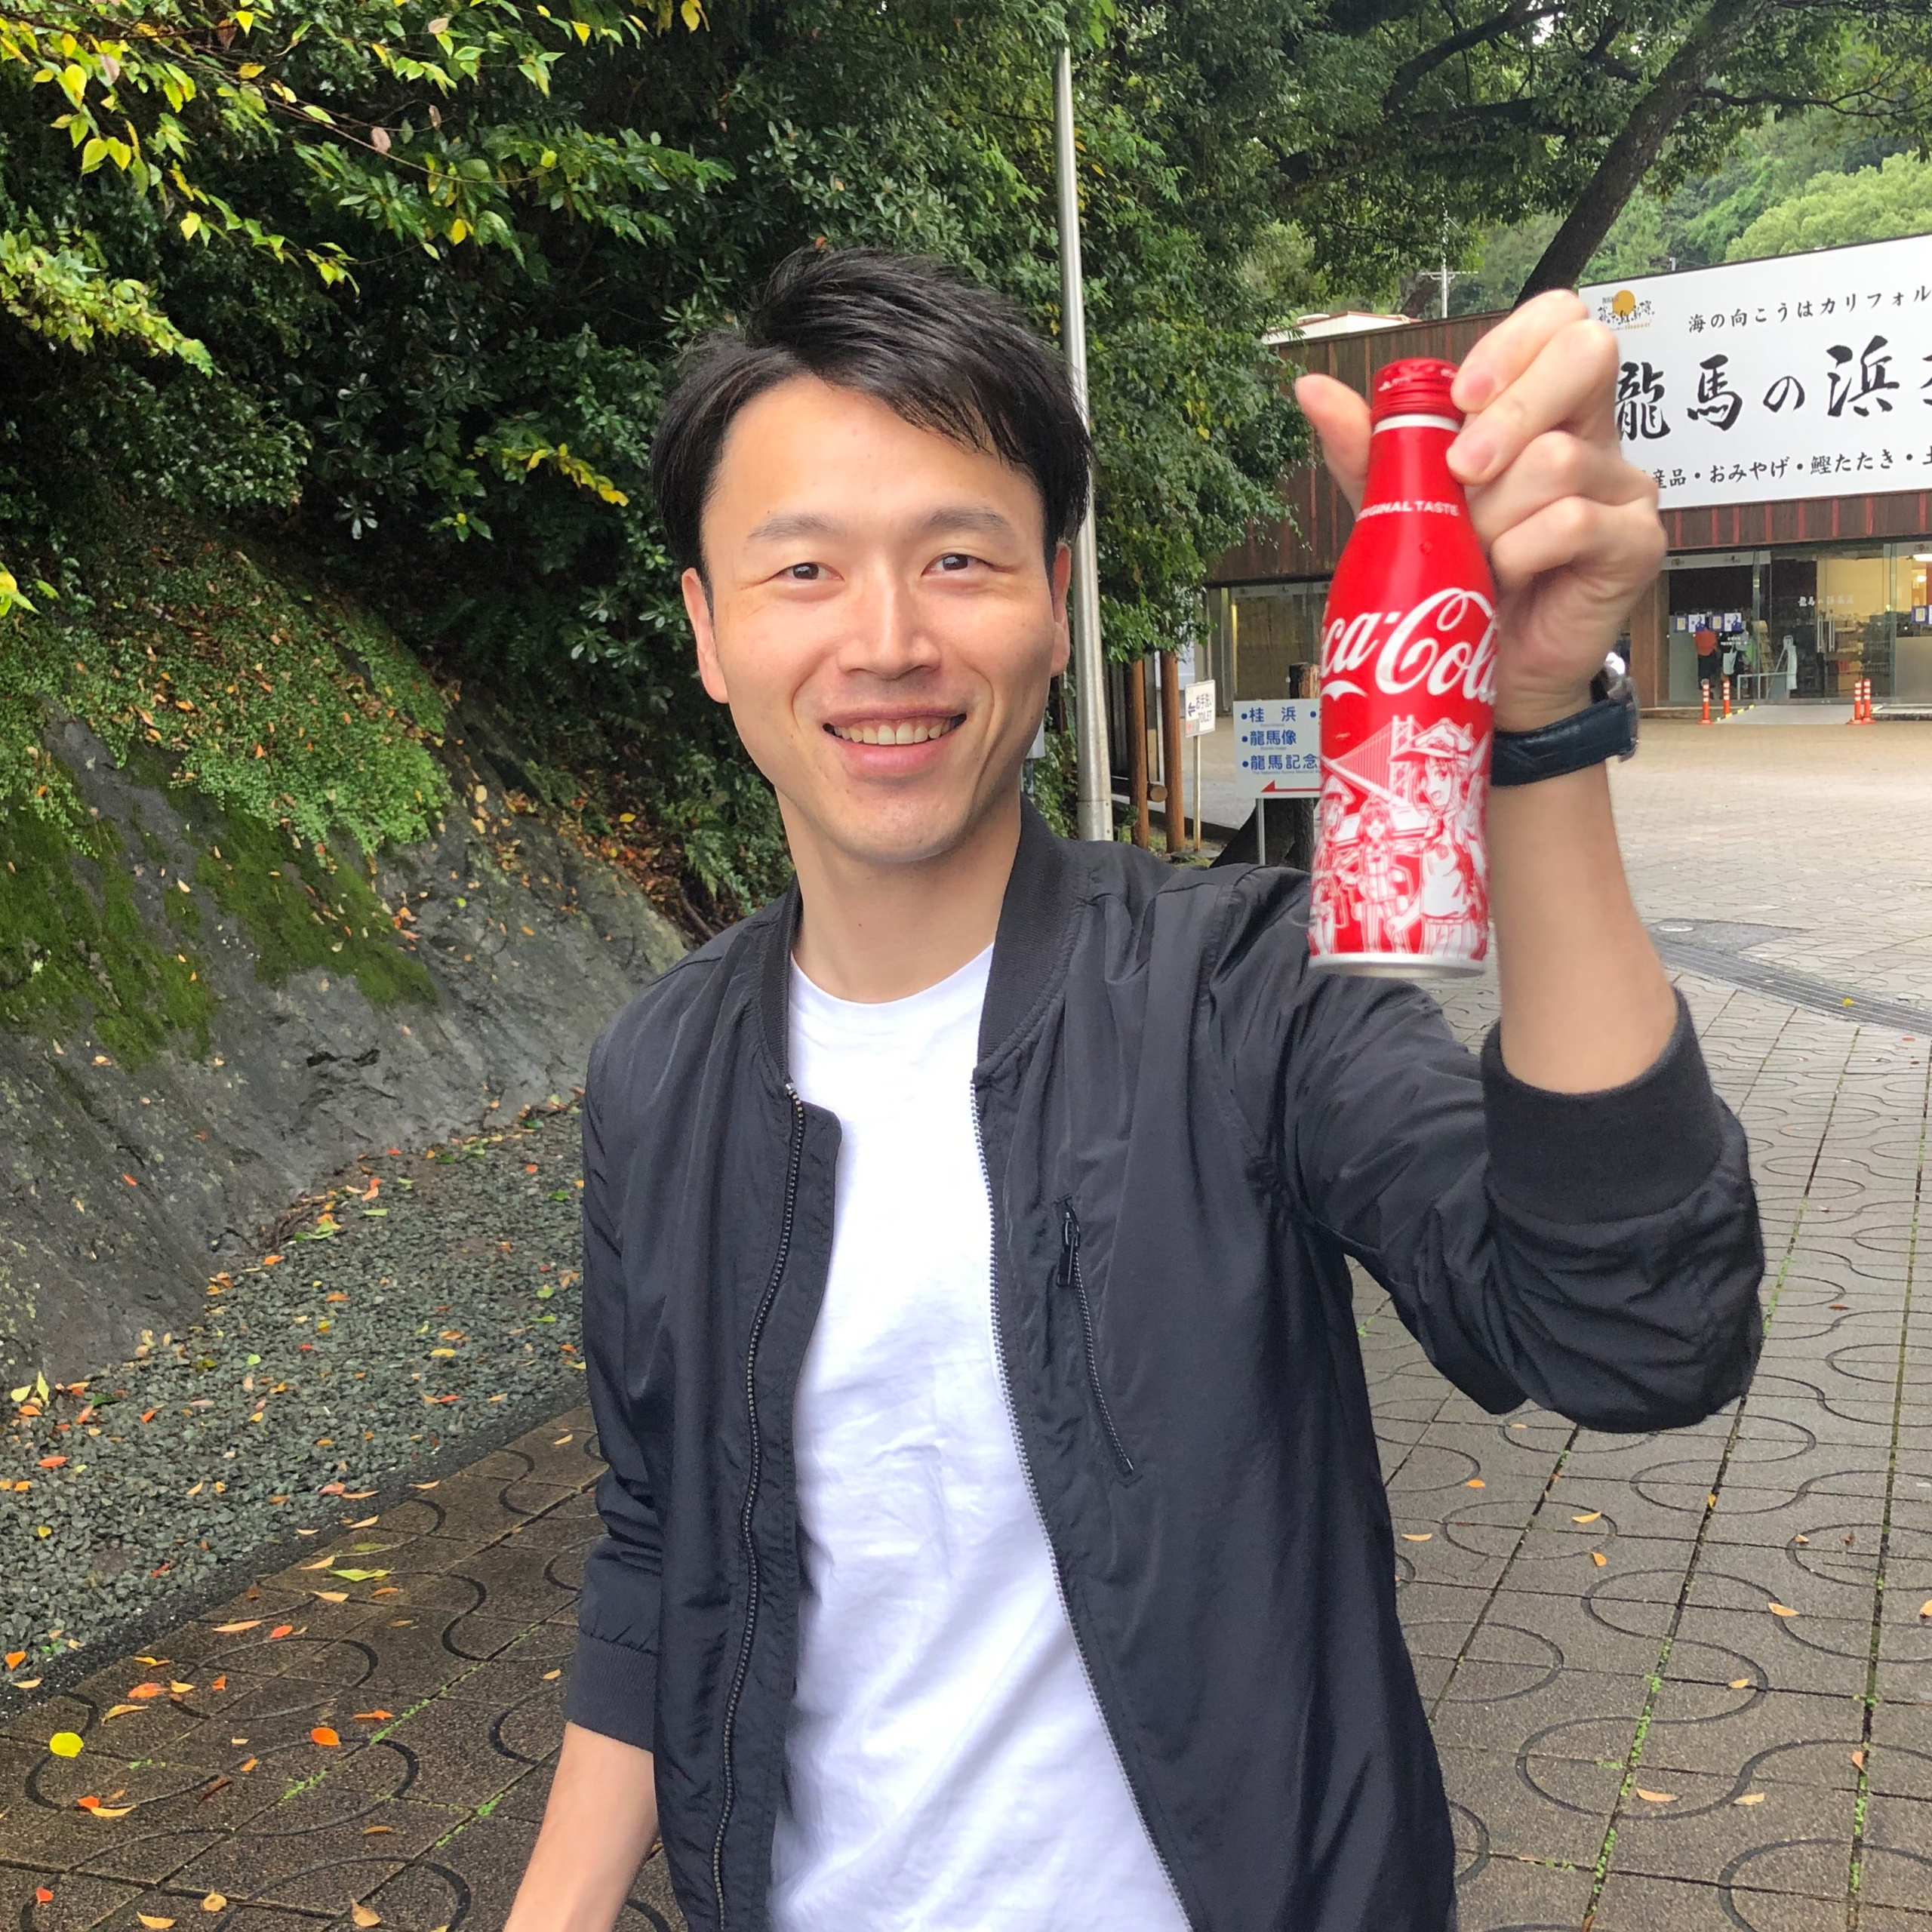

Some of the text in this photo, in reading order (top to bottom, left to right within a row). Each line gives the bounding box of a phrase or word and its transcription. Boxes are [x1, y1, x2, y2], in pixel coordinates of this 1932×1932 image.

[1414, 500, 1460, 517] TASTE
[1195, 693, 1214, 709] お手洗い
[1250, 729, 1297, 746] 龍馬像
[1251, 753, 1318, 771] 龍馬記念
